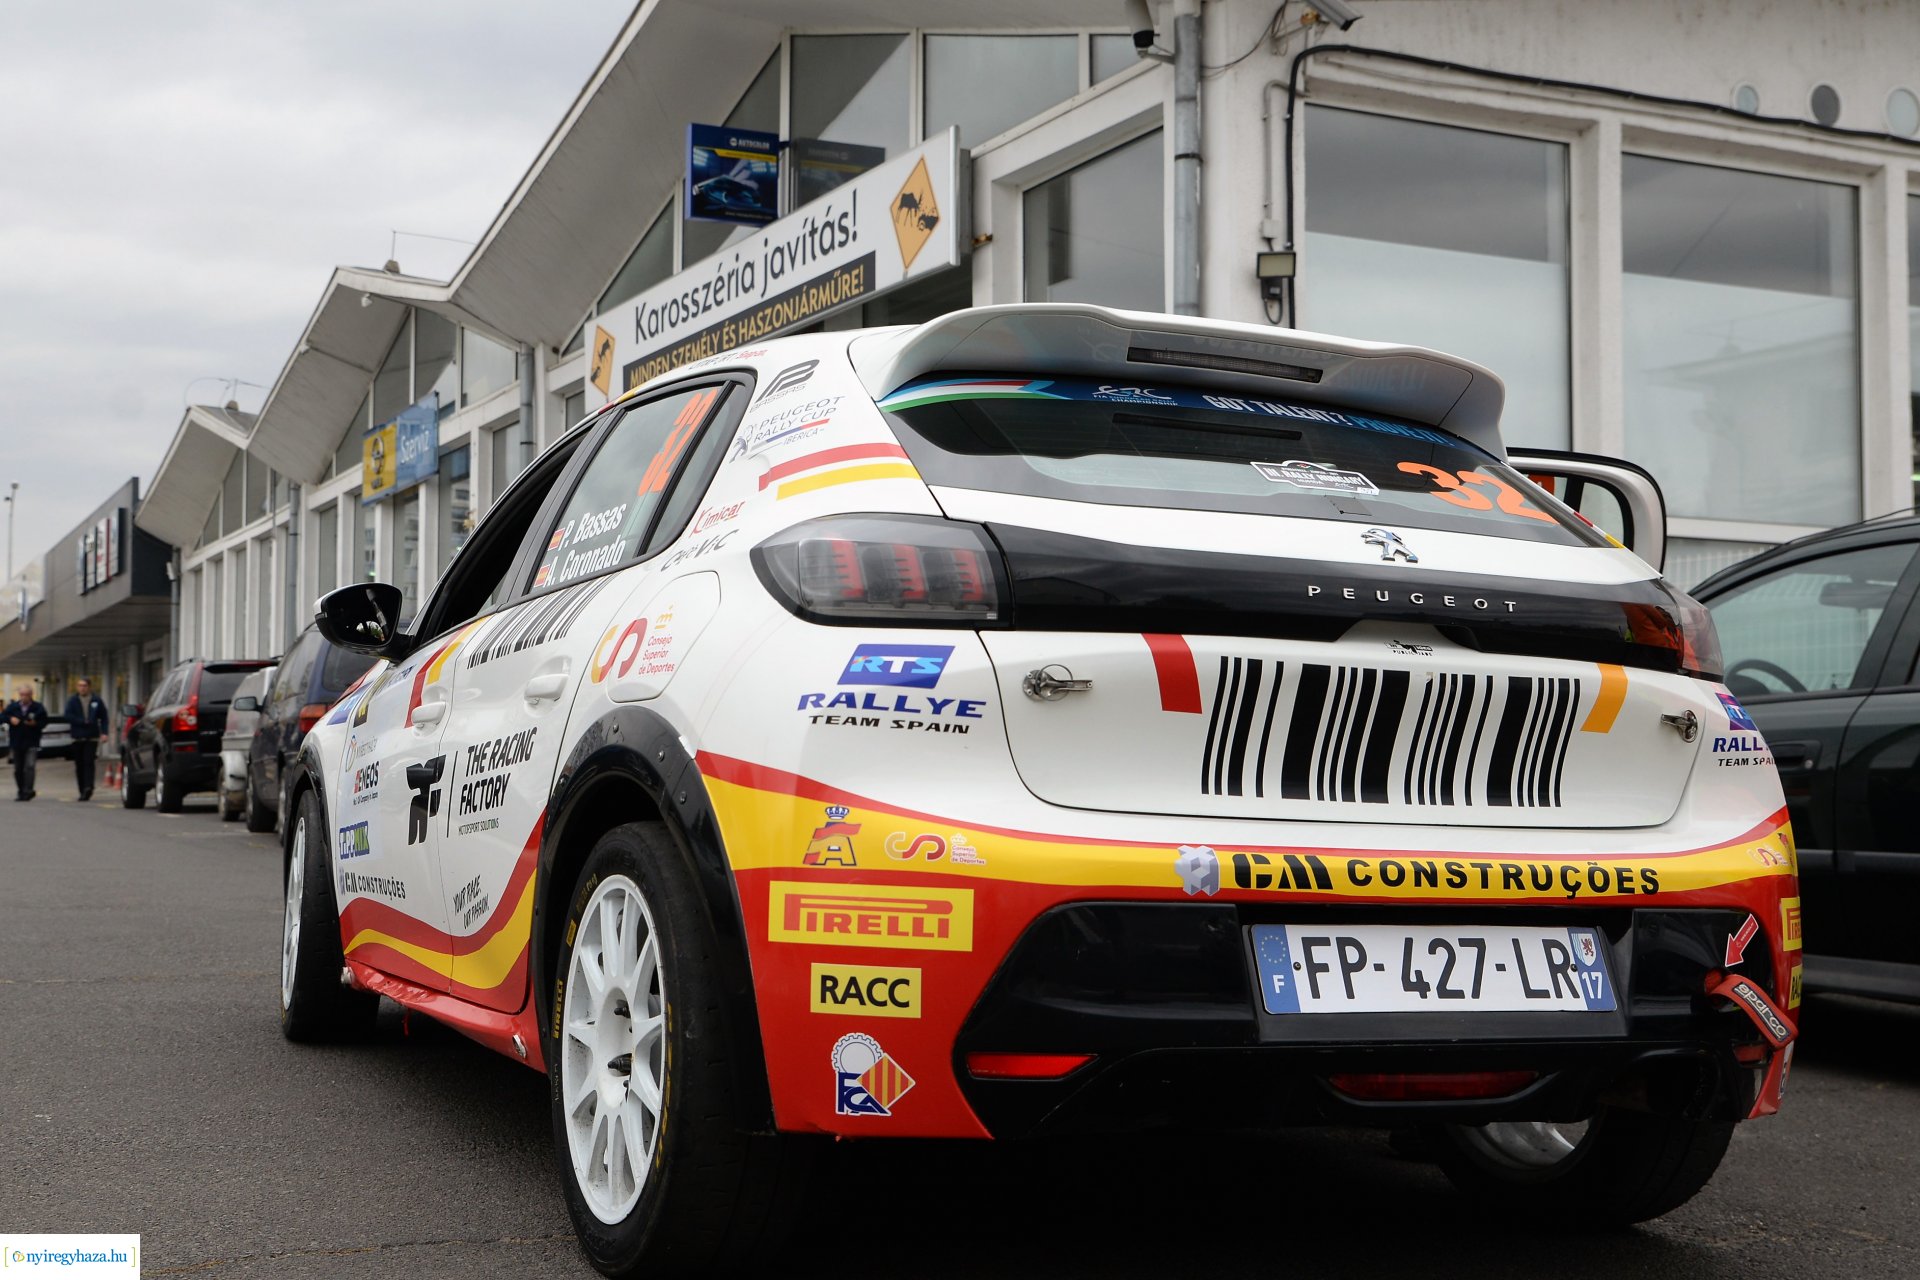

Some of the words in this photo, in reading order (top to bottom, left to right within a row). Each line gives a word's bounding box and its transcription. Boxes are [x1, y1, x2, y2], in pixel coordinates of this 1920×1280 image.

[635, 253, 755, 345] Karosszéria
[760, 188, 858, 299] javítás!
[629, 355, 671, 390] MINDEN
[671, 332, 720, 369] SZEMÉLY
[722, 322, 737, 351] ÉS
[738, 264, 865, 343] HASZONJÁRMŰRE!
[759, 396, 846, 430] PEUGEOT
[1111, 397, 1179, 407] CHAMPIONSHIP
[1202, 394, 1255, 412] GOT
[1249, 399, 1353, 426] TALENT?
[753, 415, 798, 443] RALLY
[800, 407, 837, 424] CUP
[1281, 470, 1315, 480] RALLY
[1315, 474, 1366, 486] HUNGARY
[1396, 461, 1560, 525] 32
[558, 519, 576, 551] P.
[572, 503, 627, 545] Bassas
[543, 555, 559, 588] A.
[559, 534, 626, 583] Coronado
[1307, 585, 1516, 612] PEUGEOT
[642, 648, 669, 662] Superior
[647, 635, 673, 647] Consejo
[638, 663, 647, 675] de
[646, 661, 675, 676] Deportes
[849, 655, 944, 675] RTS
[797, 691, 987, 719] RALLYE
[809, 714, 880, 728] TEAM
[890, 719, 970, 735] SPAIN
[466, 740, 491, 777] THE
[487, 726, 537, 772] RACING
[1712, 736, 1768, 753] RALL
[357, 760, 379, 792] ENEOS
[1717, 757, 1749, 767] TEAM
[1752, 756, 1776, 766] SPAI
[459, 772, 511, 816] FACTORY
[357, 875, 406, 901] CONSTRUÇÕES
[1347, 858, 1660, 899] CONSTRUÇÕES
[783, 893, 954, 939] PIRELLI
[819, 974, 911, 1008] RACC
[1272, 975, 1285, 994] F
[1580, 971, 1602, 1000] 17
[552, 978, 564, 1039] PIRELLI
[1737, 982, 1787, 1038] sparco
